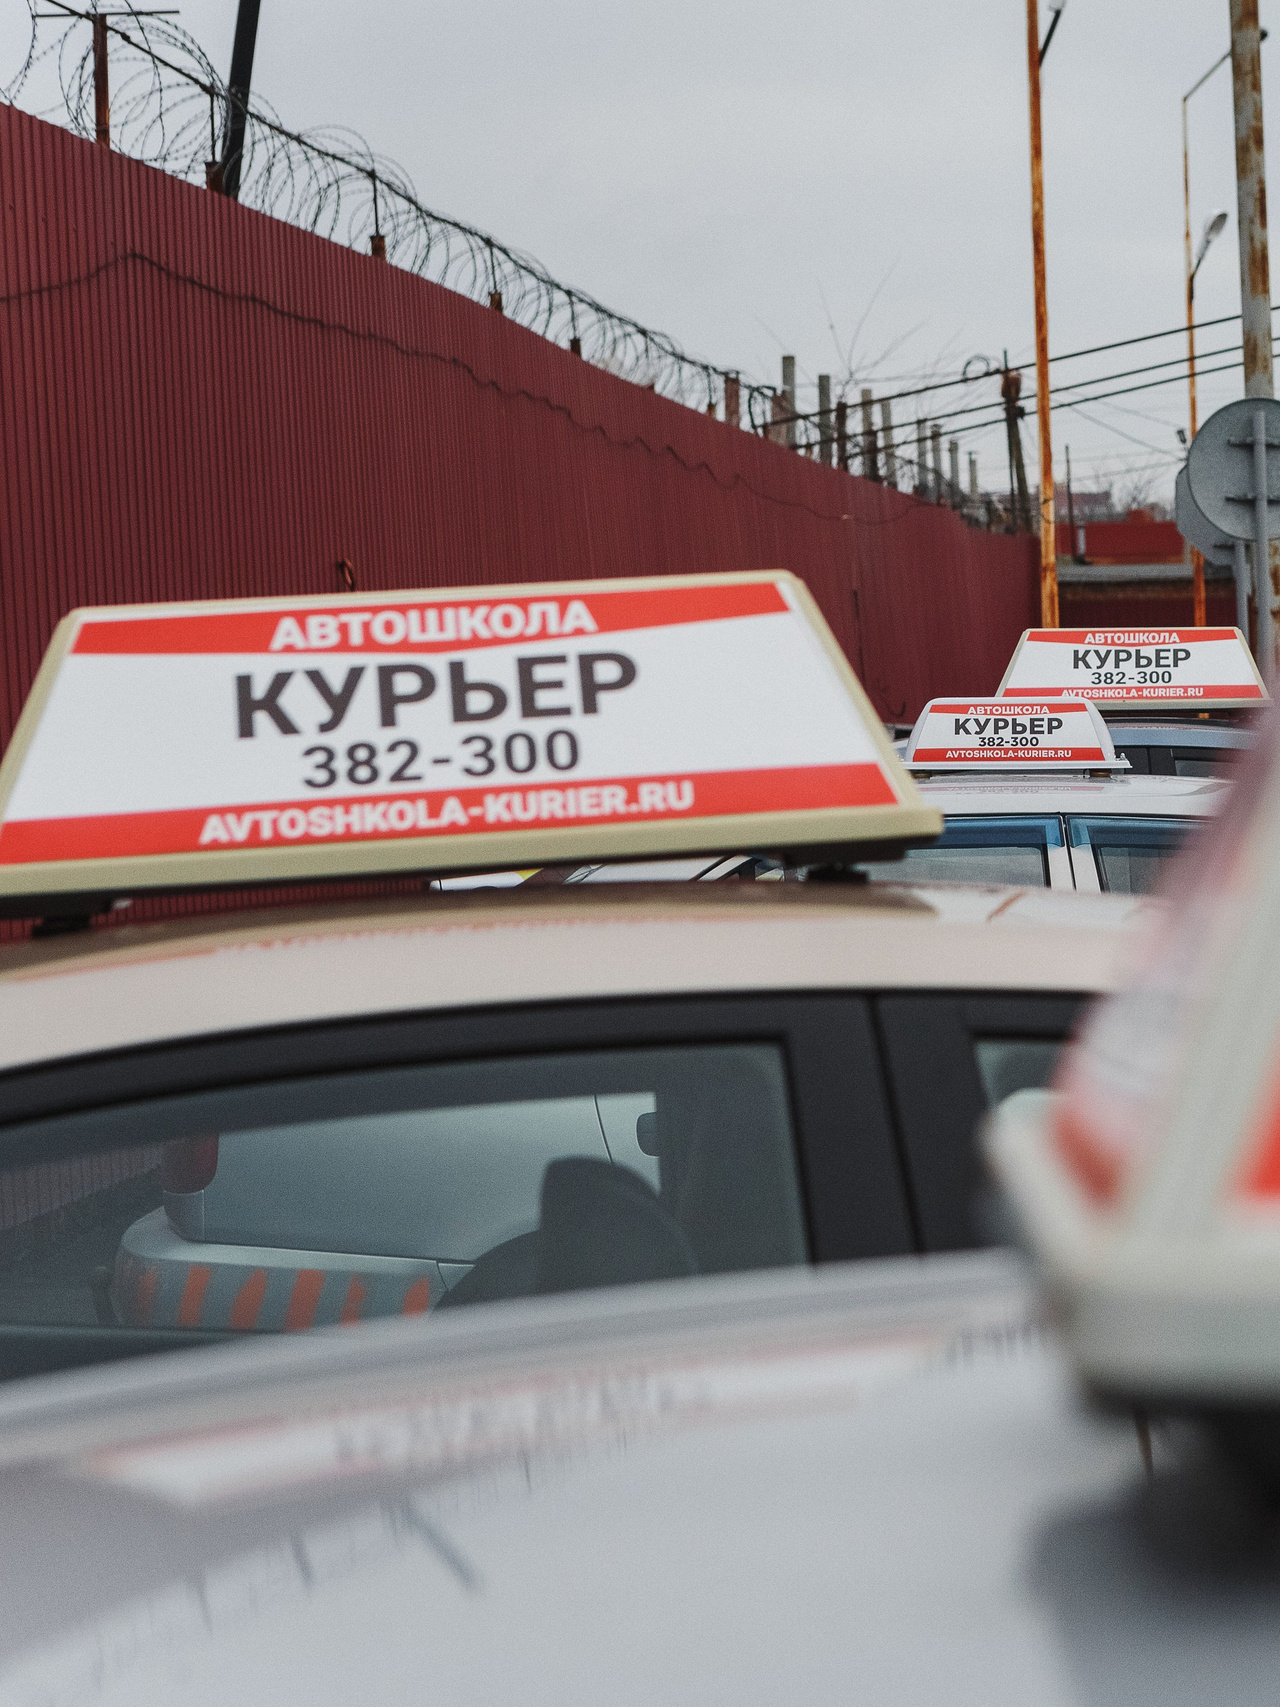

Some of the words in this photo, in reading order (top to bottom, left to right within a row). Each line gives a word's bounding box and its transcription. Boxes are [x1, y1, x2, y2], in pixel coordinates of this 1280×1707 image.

[269, 601, 599, 650] АВТОШКОЛА
[1084, 632, 1180, 645] АВТОШКОЛА
[1072, 648, 1191, 670] КУРЬЕР
[1091, 671, 1172, 685] 382-300
[234, 651, 637, 739] КУРЬЕР
[1061, 687, 1204, 698] AVTOSHKOLA-KURIER.RU
[967, 706, 1050, 715] АВТОШКОЛА
[954, 717, 1063, 736] КУРЬЕР
[978, 736, 1039, 747] 382-300
[301, 730, 581, 789] 382-300
[945, 749, 1072, 759] AVTOSHKOLA-KURIER.RU
[199, 781, 695, 845] AVTOSHKOLA-KURIER.RU
